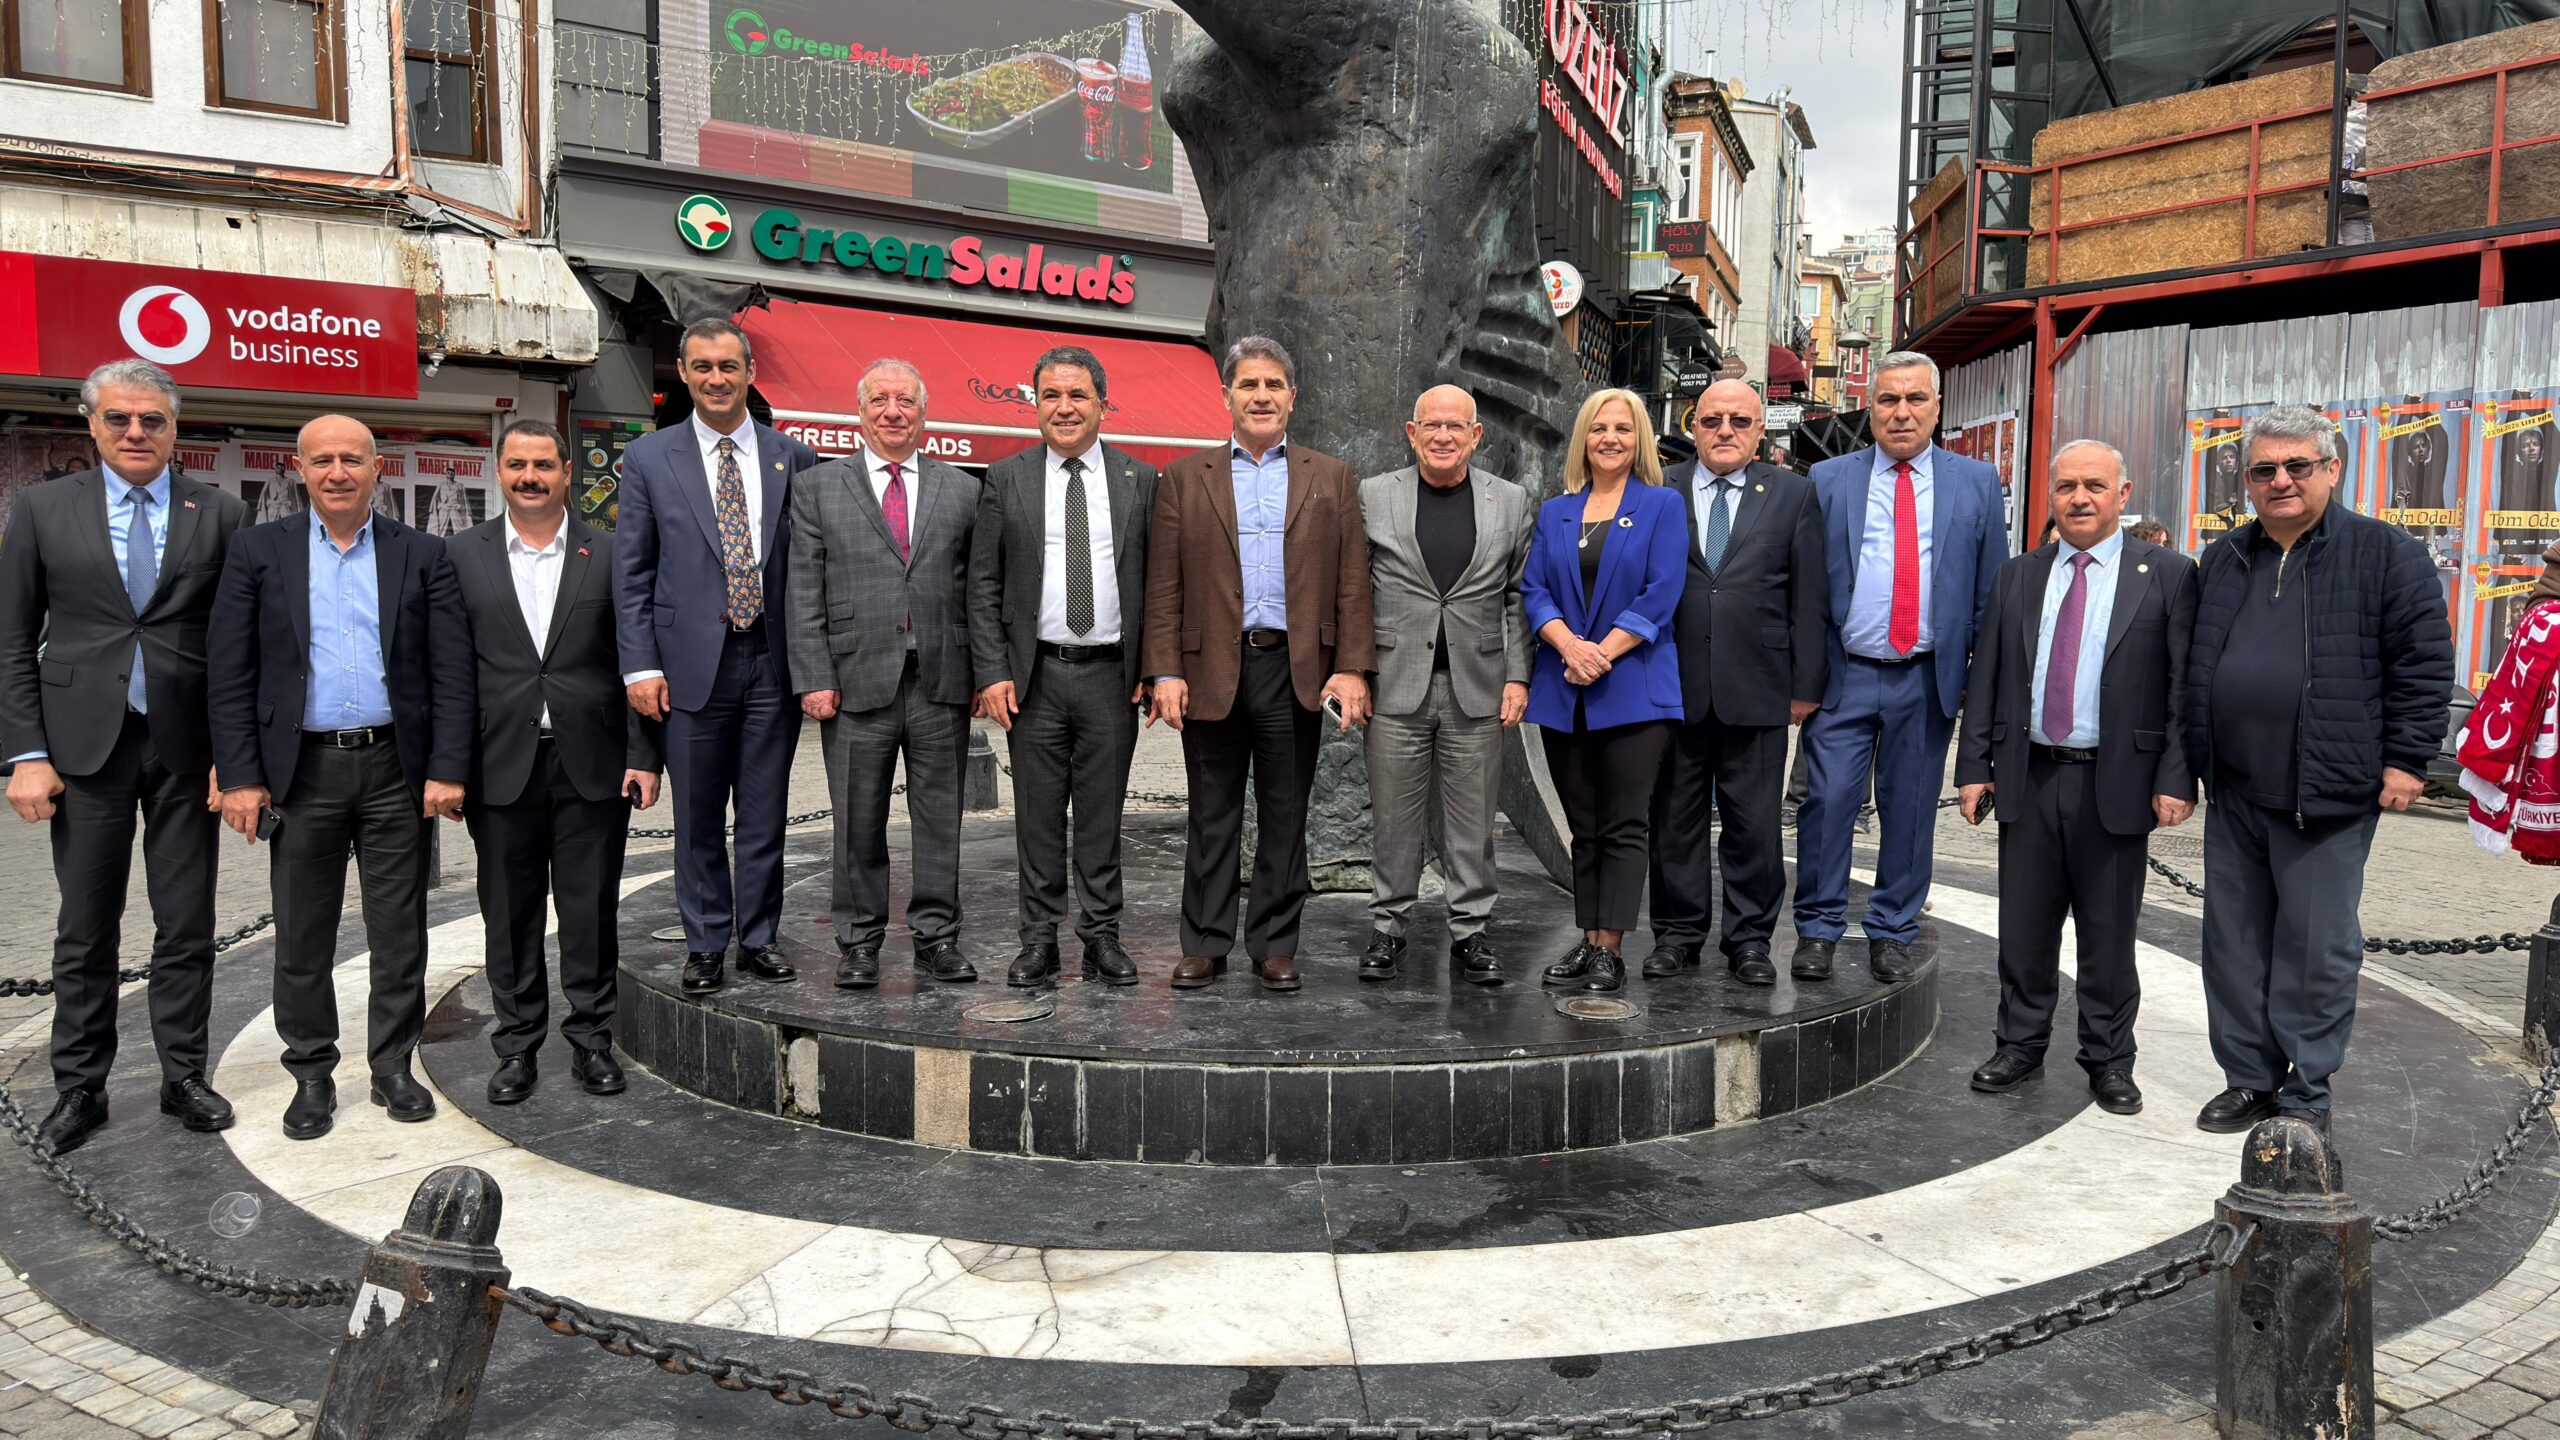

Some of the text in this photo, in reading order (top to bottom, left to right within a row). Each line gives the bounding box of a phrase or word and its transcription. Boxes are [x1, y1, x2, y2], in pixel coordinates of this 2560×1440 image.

[1576, 125, 1623, 201] KURUMLARI
[1662, 223, 1703, 238] HOLY
[752, 207, 1137, 305] GreenSalads
[226, 305, 381, 338] vodafone
[230, 334, 359, 368] business
[1680, 373, 1708, 381] GREATNESS
[2521, 418, 2536, 427] LIFE
[784, 426, 972, 457] GREEN ADS
[2417, 510, 2456, 524] Odell
[2490, 513, 2560, 528] Tom Ode
